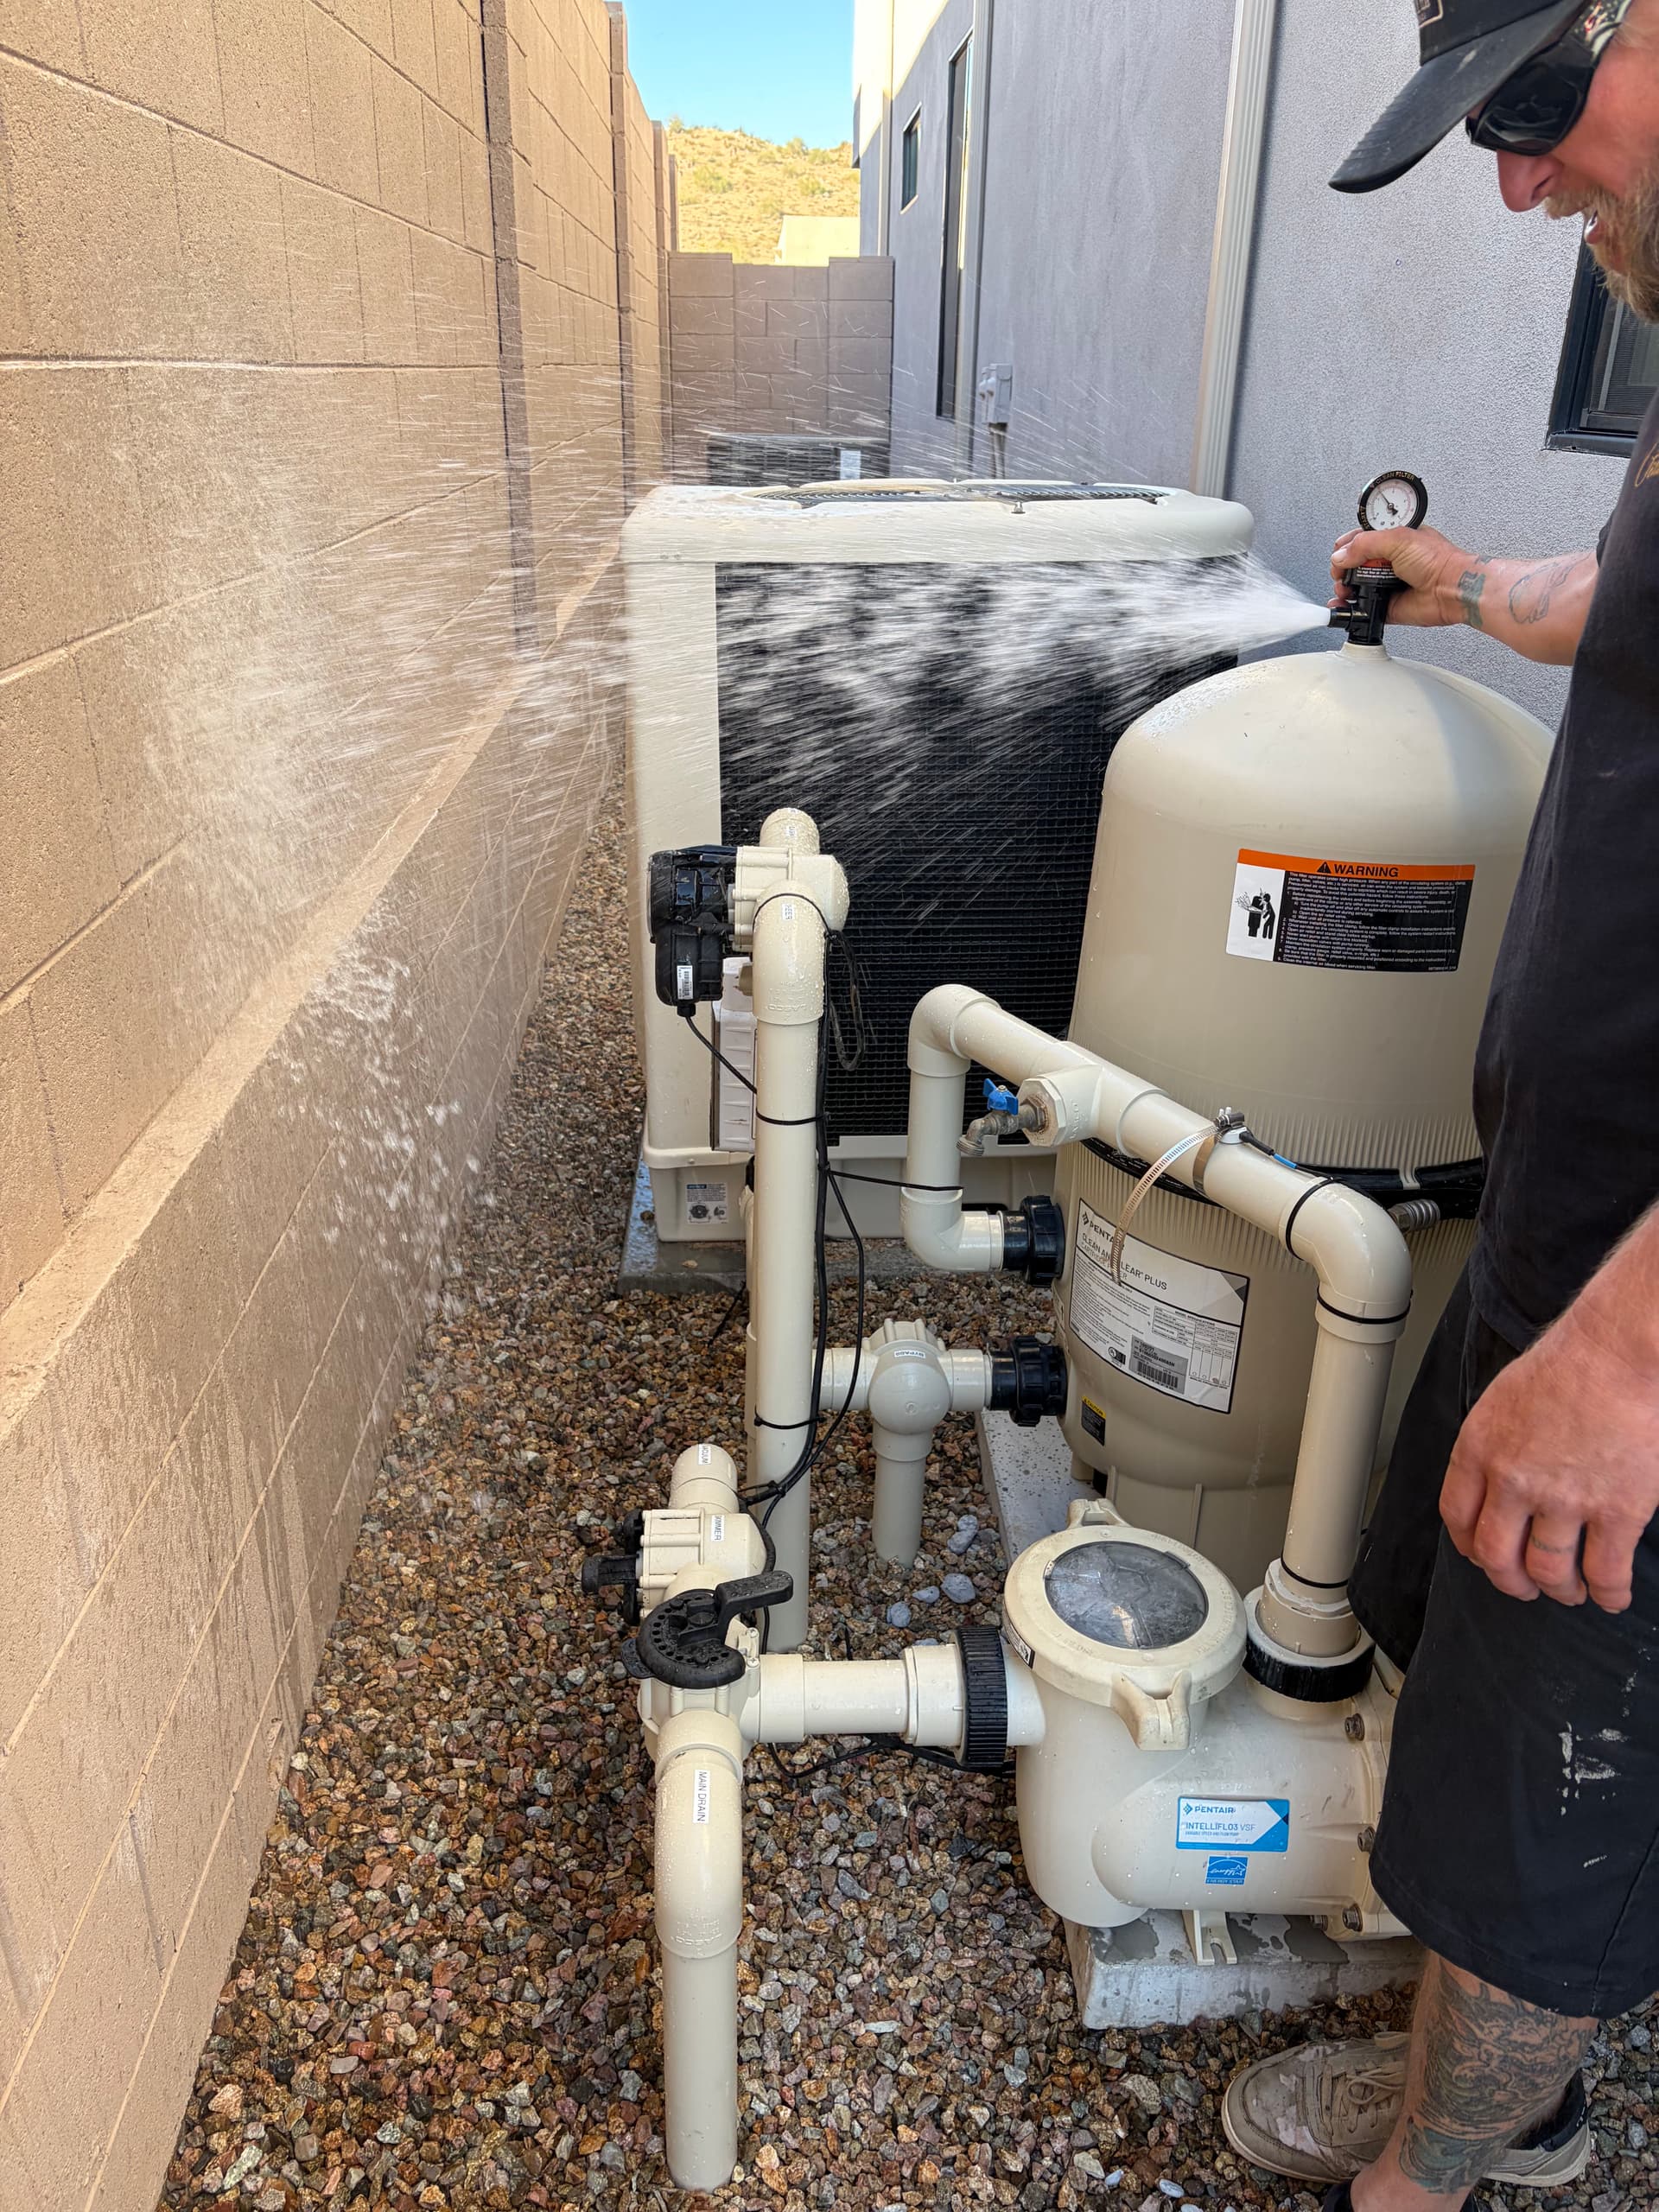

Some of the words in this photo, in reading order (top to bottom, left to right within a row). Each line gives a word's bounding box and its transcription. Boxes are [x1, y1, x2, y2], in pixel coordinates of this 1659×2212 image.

[1395, 471, 1415, 481] FILTER
[1334, 864, 1398, 877] WARNING
[1082, 1233, 1101, 1253] CLEAN
[1120, 1261, 1143, 1278] LEAR
[1144, 1274, 1167, 1290] PLUS
[697, 1771, 708, 1791] MAIN
[696, 1793, 707, 1821] DRAIN
[1185, 1822, 1238, 1831] INTELLIFLO3
